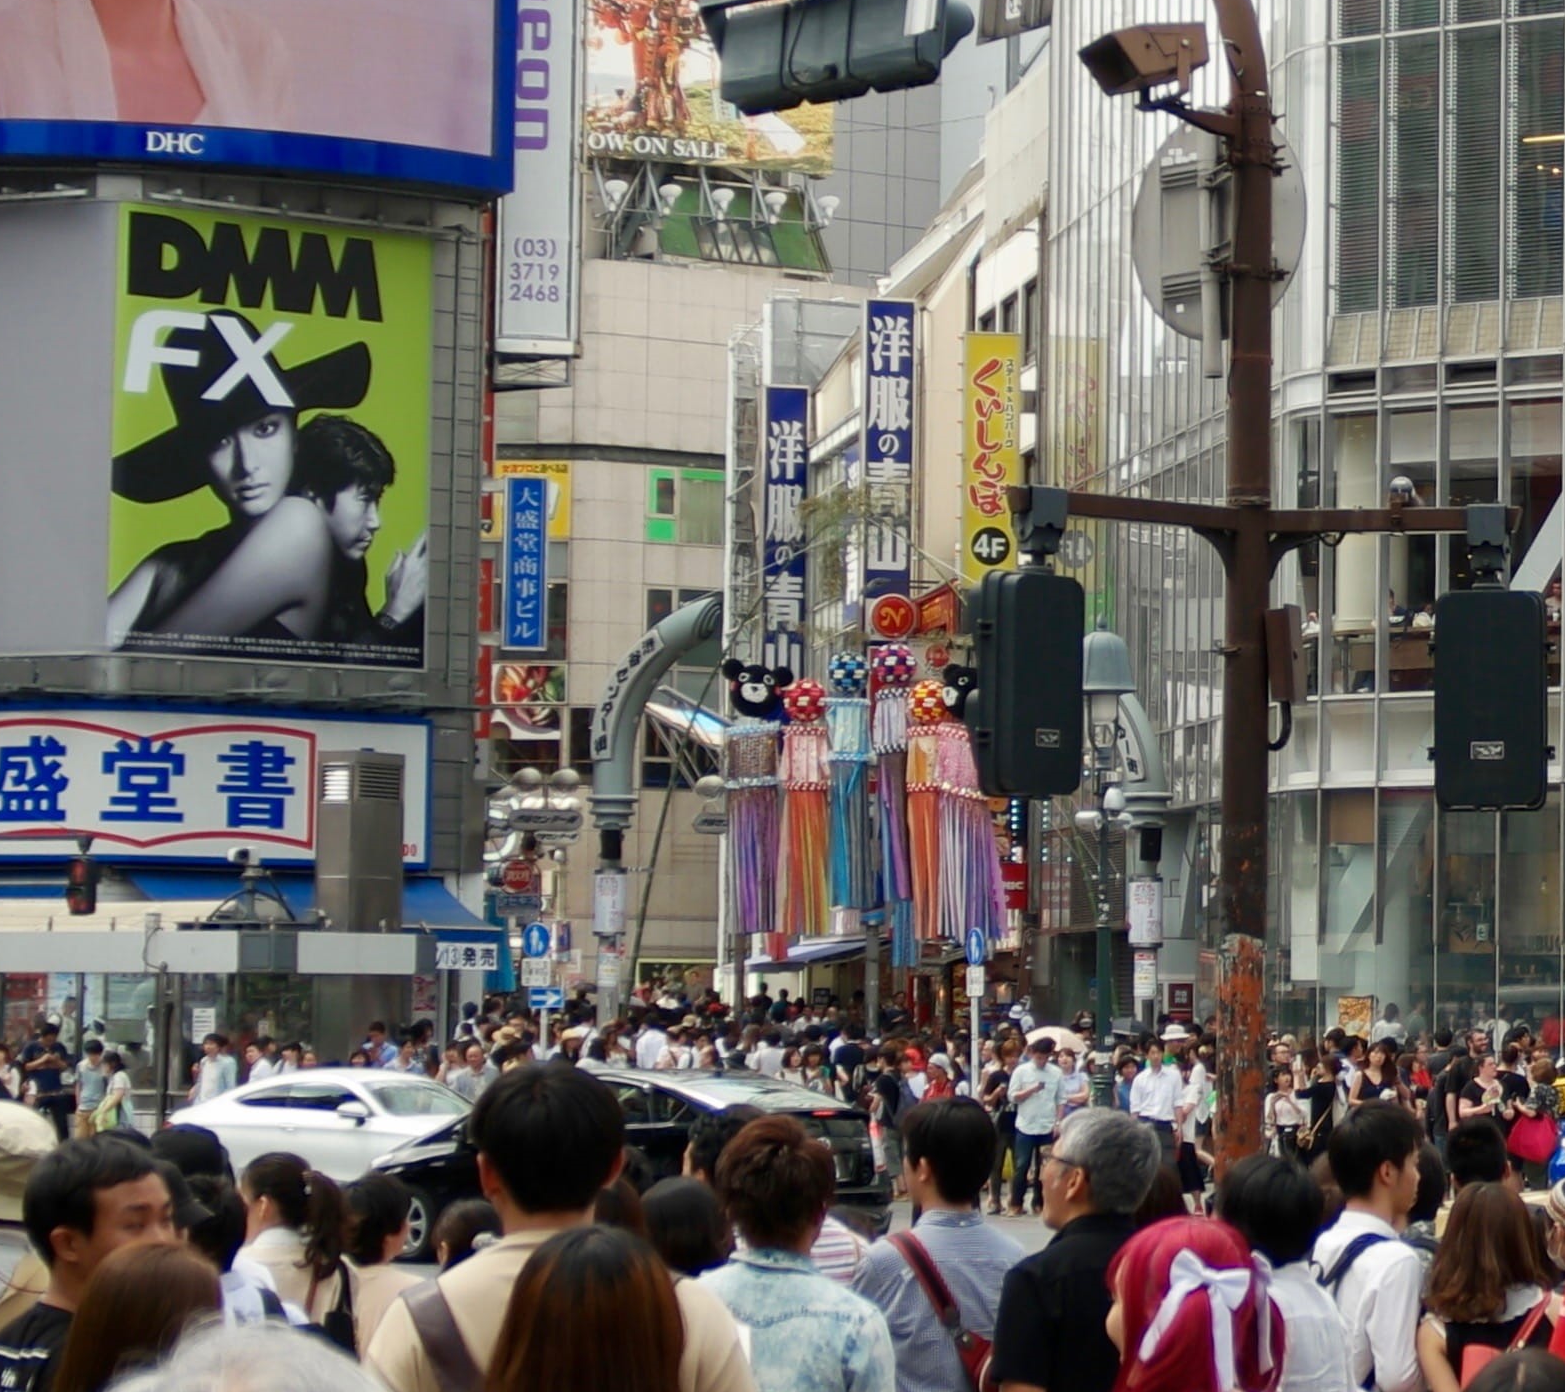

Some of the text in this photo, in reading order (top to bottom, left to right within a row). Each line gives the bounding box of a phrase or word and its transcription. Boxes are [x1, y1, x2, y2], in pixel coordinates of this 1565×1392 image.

[146, 130, 205, 155] DHC
[635, 134, 667, 156] ON
[672, 138, 728, 160] SALE
[513, 238, 557, 257] (03)
[127, 211, 383, 322] DMM
[509, 263, 560, 281] 3719
[508, 284, 560, 303] 2468
[122, 310, 296, 409] FX
[867, 313, 913, 572] 洋服の青山
[972, 535, 1007, 560] 4F
[512, 485, 539, 640] 大盛堂商事ビル
